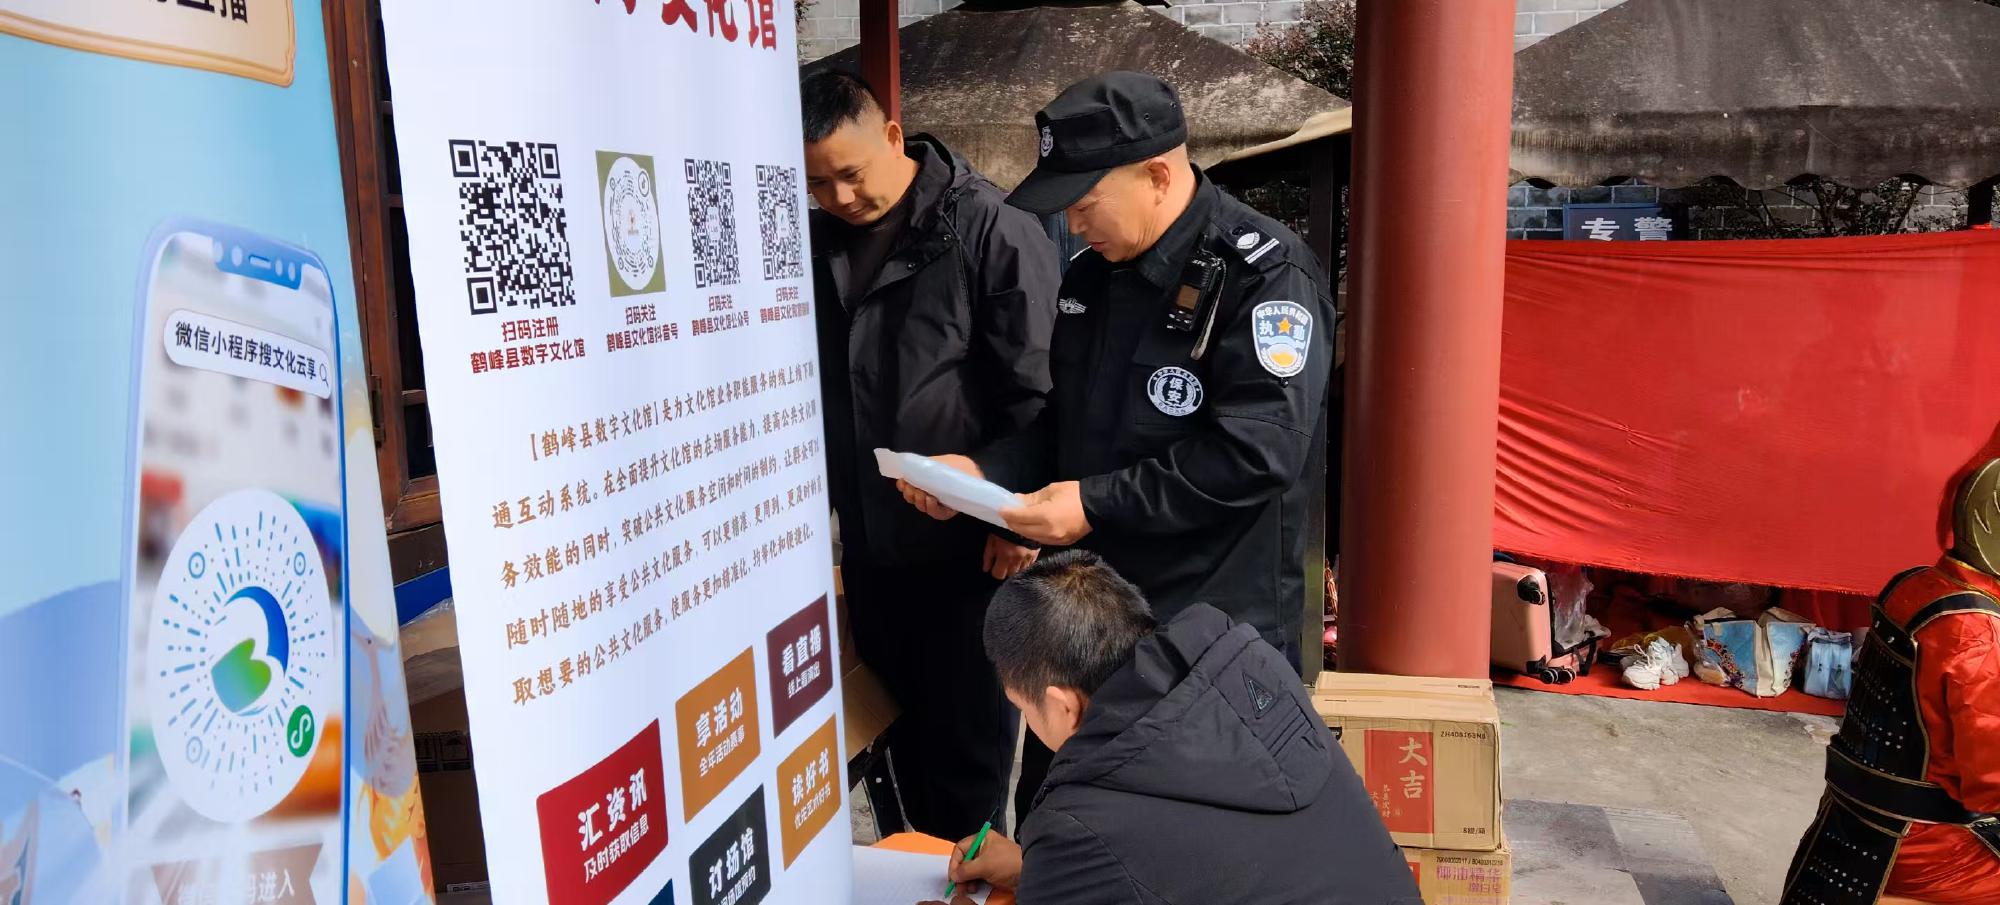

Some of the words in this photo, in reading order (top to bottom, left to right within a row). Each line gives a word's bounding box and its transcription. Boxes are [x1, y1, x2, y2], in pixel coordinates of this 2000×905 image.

[625, 303, 656, 324] 扫码关注
[692, 310, 749, 337] 鹤峰县文化馆公众号
[708, 294, 733, 312] 扫码关注
[175, 321, 317, 380] 微信小程序搜文化云享
[501, 316, 559, 343] 扫码注册
[607, 323, 679, 352] 鹤峰县文化馆抖音号
[471, 338, 586, 374] 鹤峰县数字文化馆
[1167, 377, 1184, 403] 保安
[782, 624, 822, 676] 看直播
[695, 687, 743, 748] 享活动
[792, 748, 829, 806] 读好书
[1399, 737, 1428, 799] 大吉
[578, 767, 648, 851] 汇资讯
[583, 813, 649, 883] 及时获取信息
[709, 827, 754, 899] 订场馆
